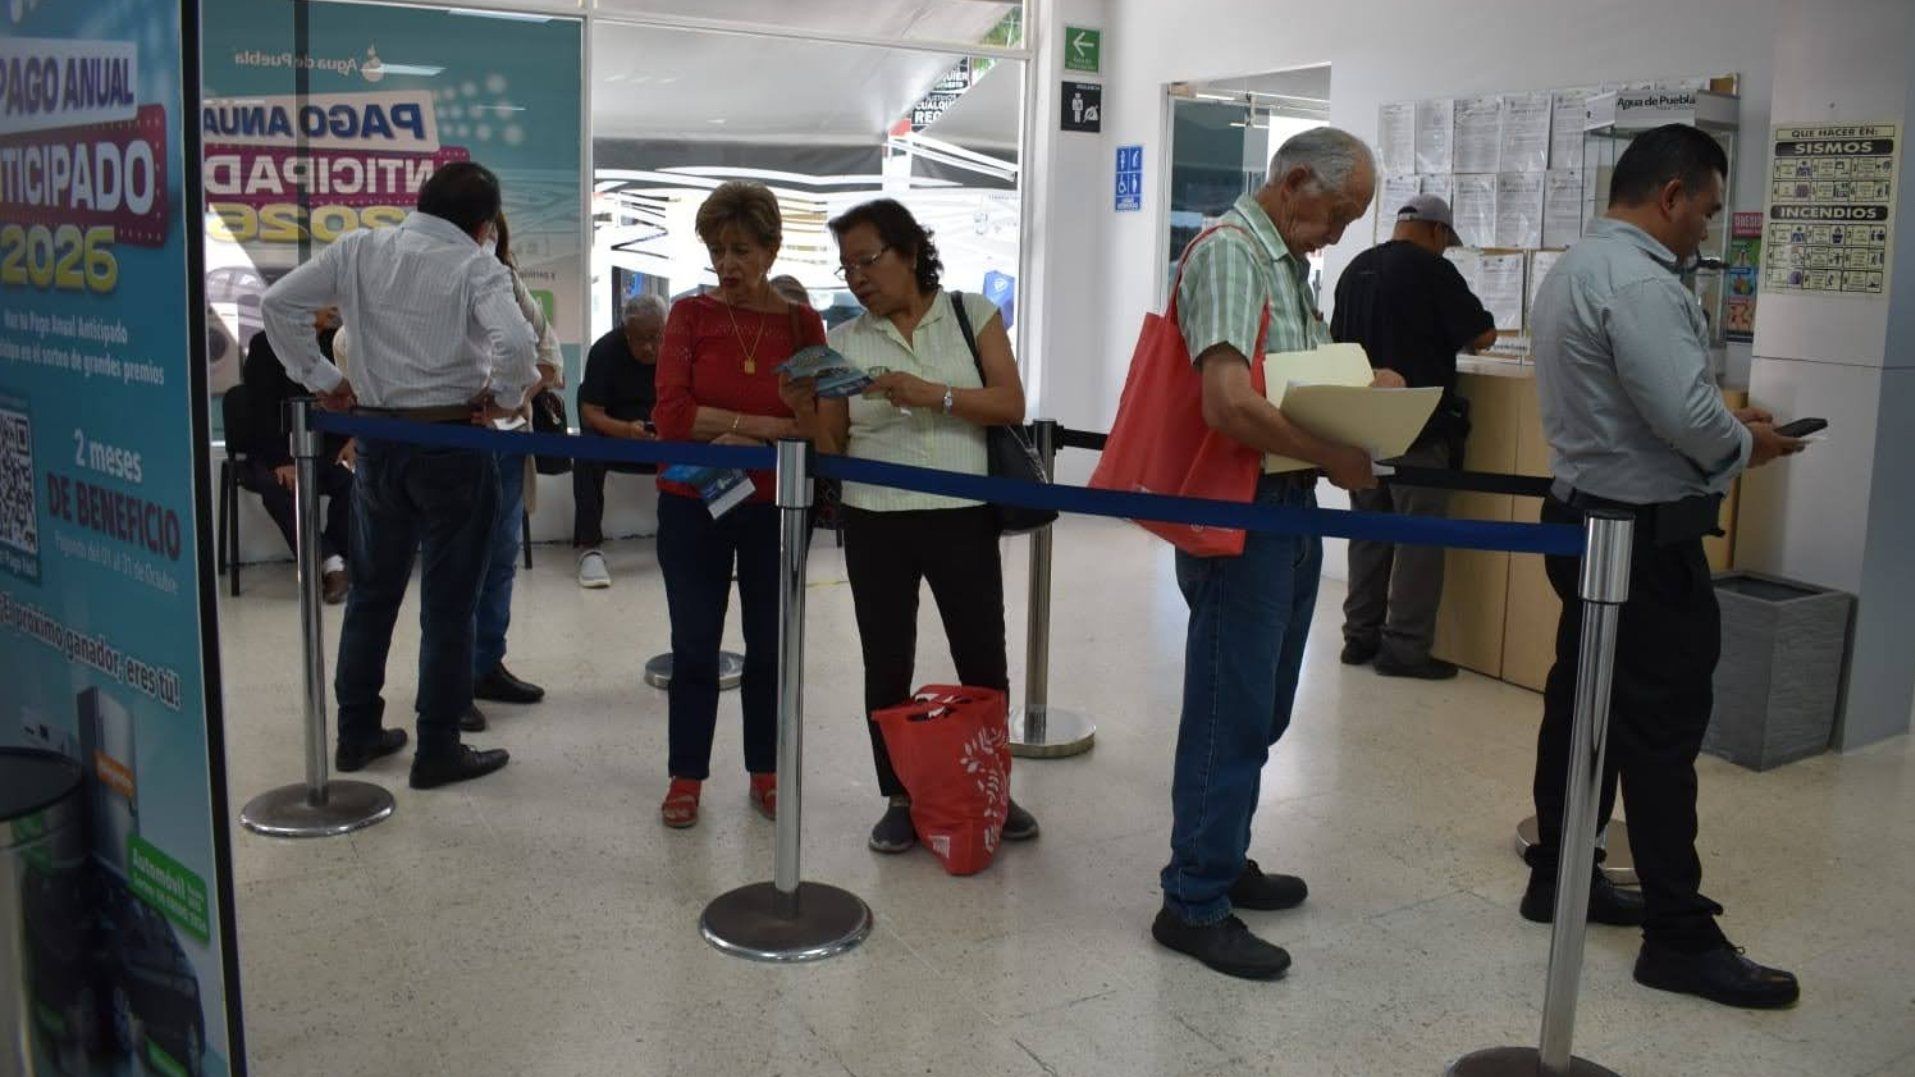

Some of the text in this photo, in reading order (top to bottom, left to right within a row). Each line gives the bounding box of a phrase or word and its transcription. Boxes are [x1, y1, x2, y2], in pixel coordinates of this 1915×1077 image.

[62, 57, 134, 111] ANUAL
[1618, 97, 1643, 110] Agua
[1645, 96, 1658, 106] de
[1660, 94, 1696, 105] Puebla
[1792, 126, 1878, 139] QUE HACER EN:
[1794, 141, 1873, 154] SISMOS
[0, 139, 155, 216] TICIPADO
[1780, 206, 1878, 220] INCENDIOS
[1, 224, 118, 294] 2026
[78, 316, 128, 348] Anticipado
[83, 352, 122, 378] grandes
[123, 359, 165, 386] premios
[74, 427, 143, 484] 2 meses
[47, 471, 181, 562] DE BENEFICIO
[65, 633, 123, 684] ganador,
[126, 656, 156, 697] eres
[157, 667, 181, 711] tú!
